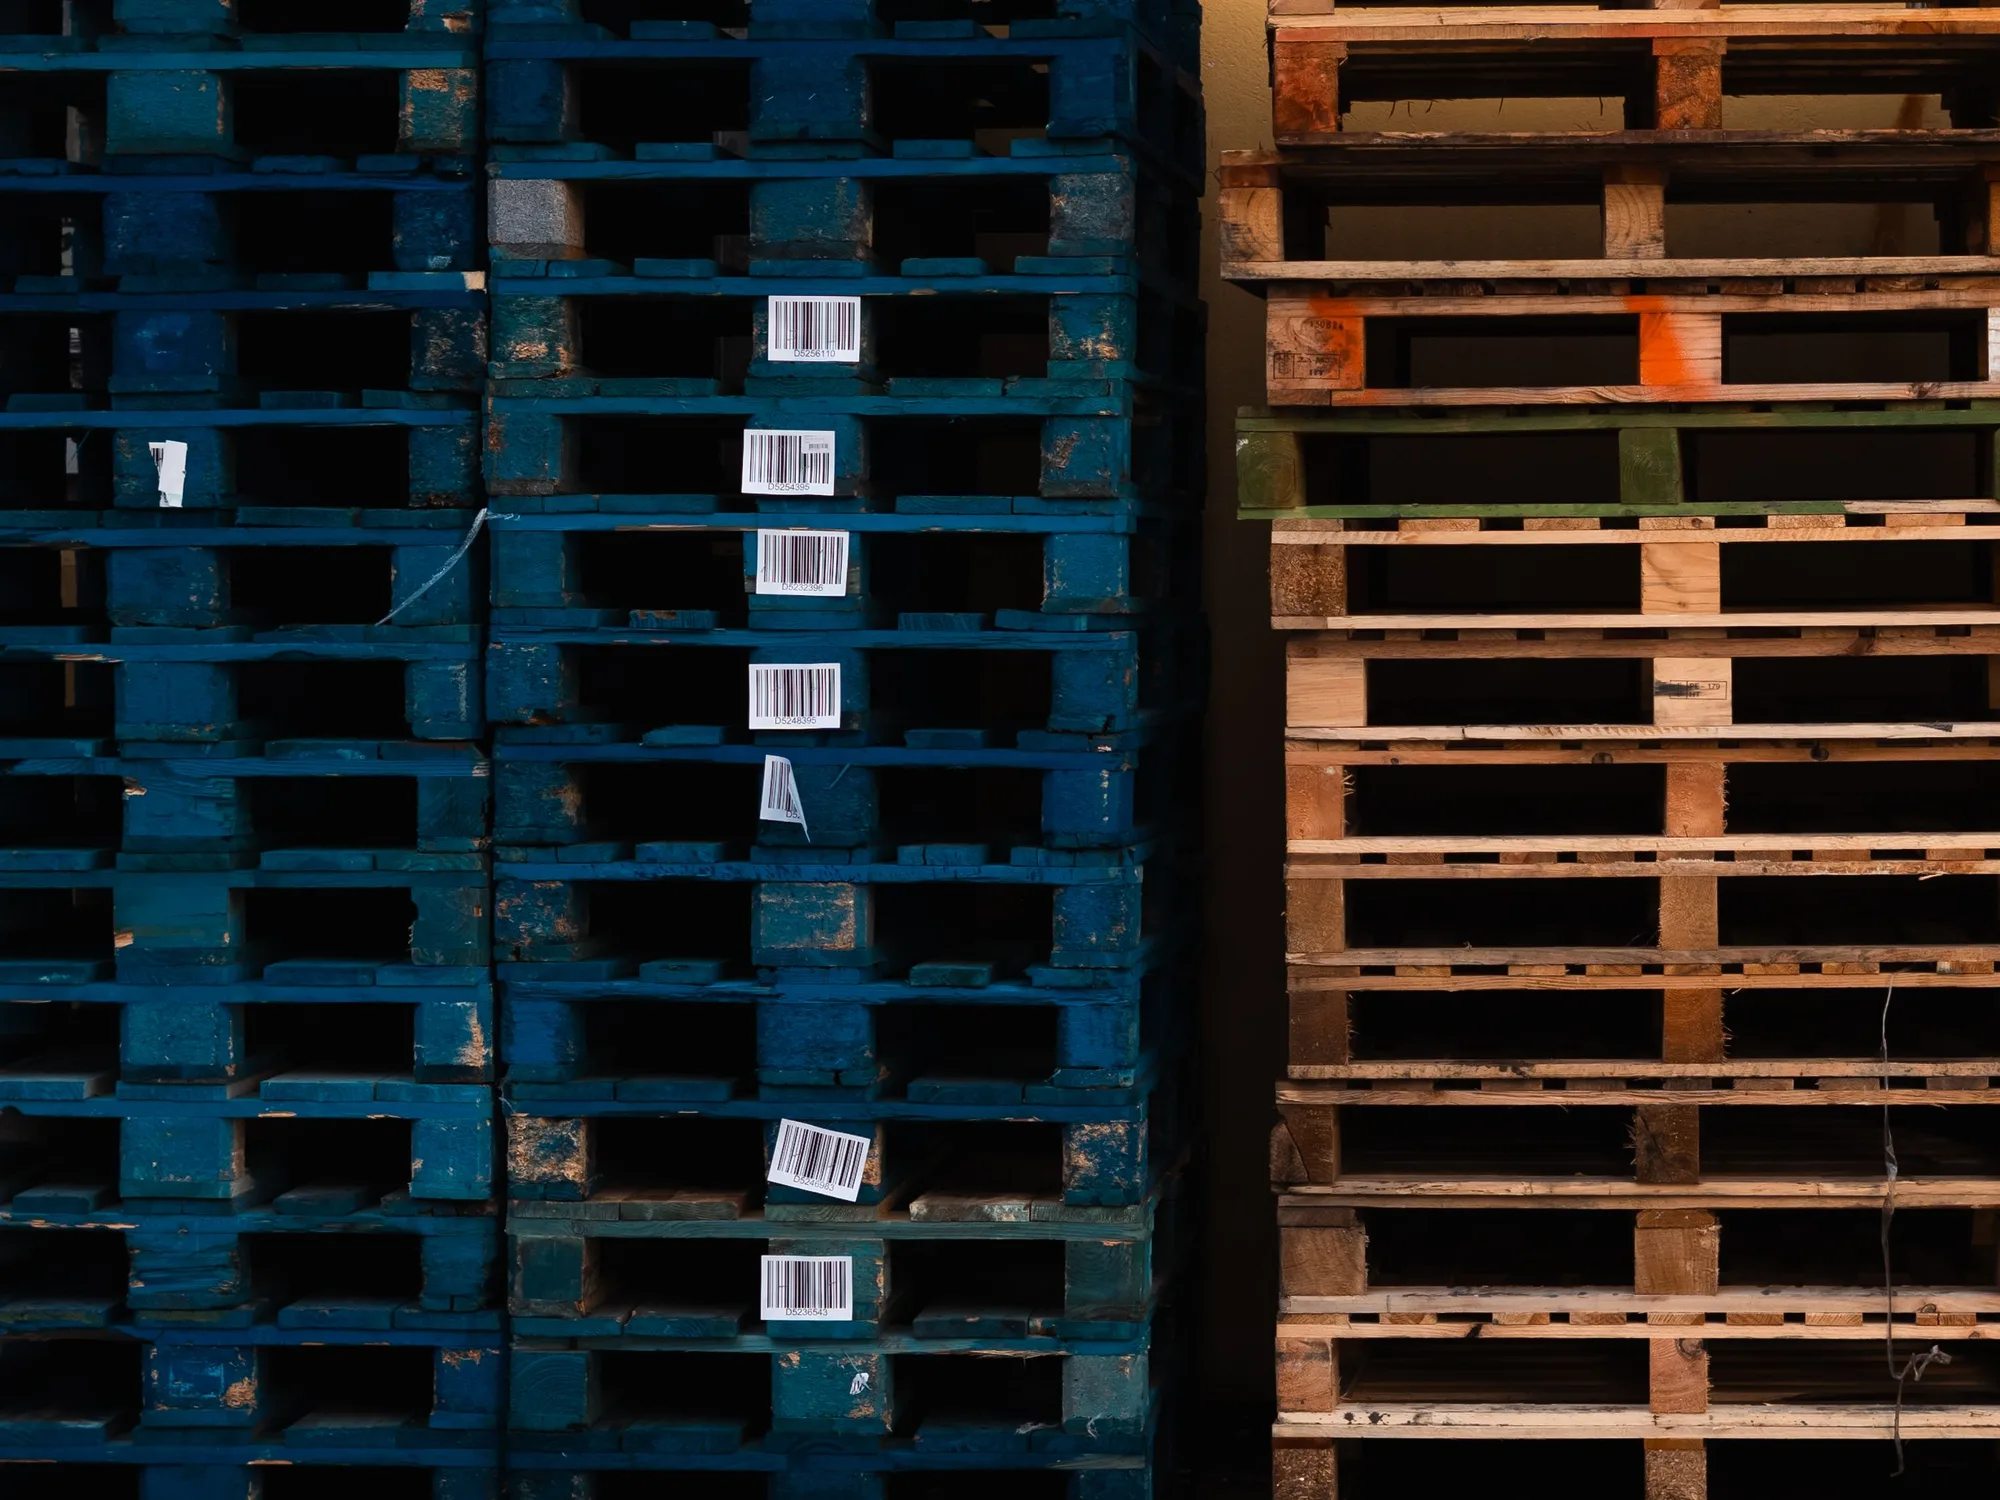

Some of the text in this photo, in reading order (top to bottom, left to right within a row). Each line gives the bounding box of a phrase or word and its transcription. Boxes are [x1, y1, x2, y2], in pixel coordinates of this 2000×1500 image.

[794, 350, 836, 358] D5256110
[768, 482, 811, 491] D5254395
[782, 583, 825, 592] D5232396
[774, 717, 817, 725] D5248395
[793, 1175, 835, 1192] D5246983
[785, 1308, 828, 1316] D5236543
